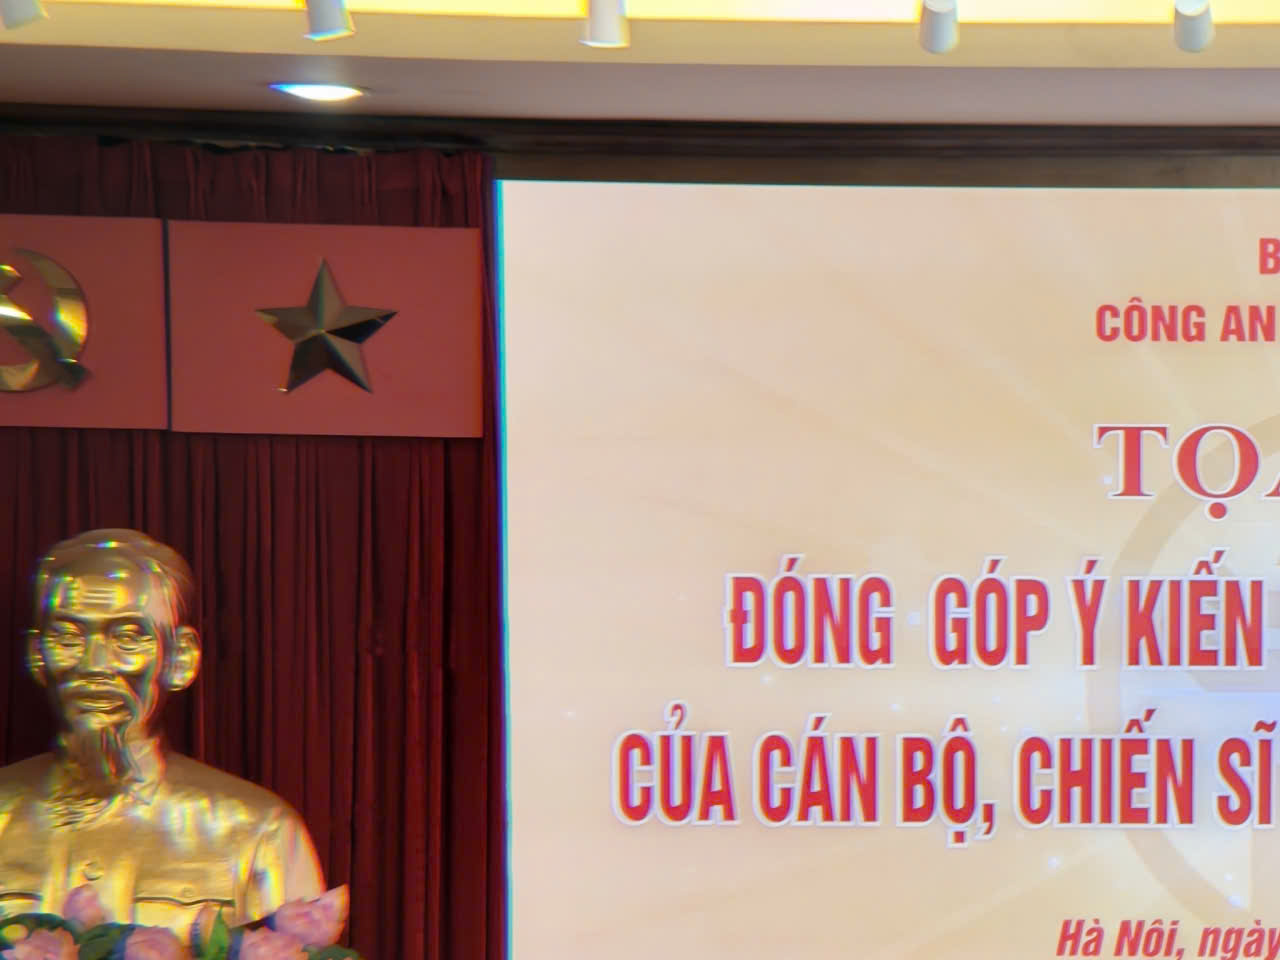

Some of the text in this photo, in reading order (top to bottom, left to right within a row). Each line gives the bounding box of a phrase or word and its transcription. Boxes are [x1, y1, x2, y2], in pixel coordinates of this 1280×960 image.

[1095, 296, 1205, 344] CÔNG
[1220, 303, 1276, 343] AN
[730, 557, 893, 666] ĐÓNG
[935, 559, 1049, 667] GÓP
[1071, 559, 1106, 666] Ý
[1128, 551, 1264, 667] KIẾN
[617, 703, 735, 823] CỦA
[757, 716, 879, 823] CÁN
[901, 717, 995, 844] BỘ,
[1018, 709, 1196, 825] CHIẾN
[1217, 721, 1277, 826] SĨ
[1054, 918, 1104, 958] Hà
